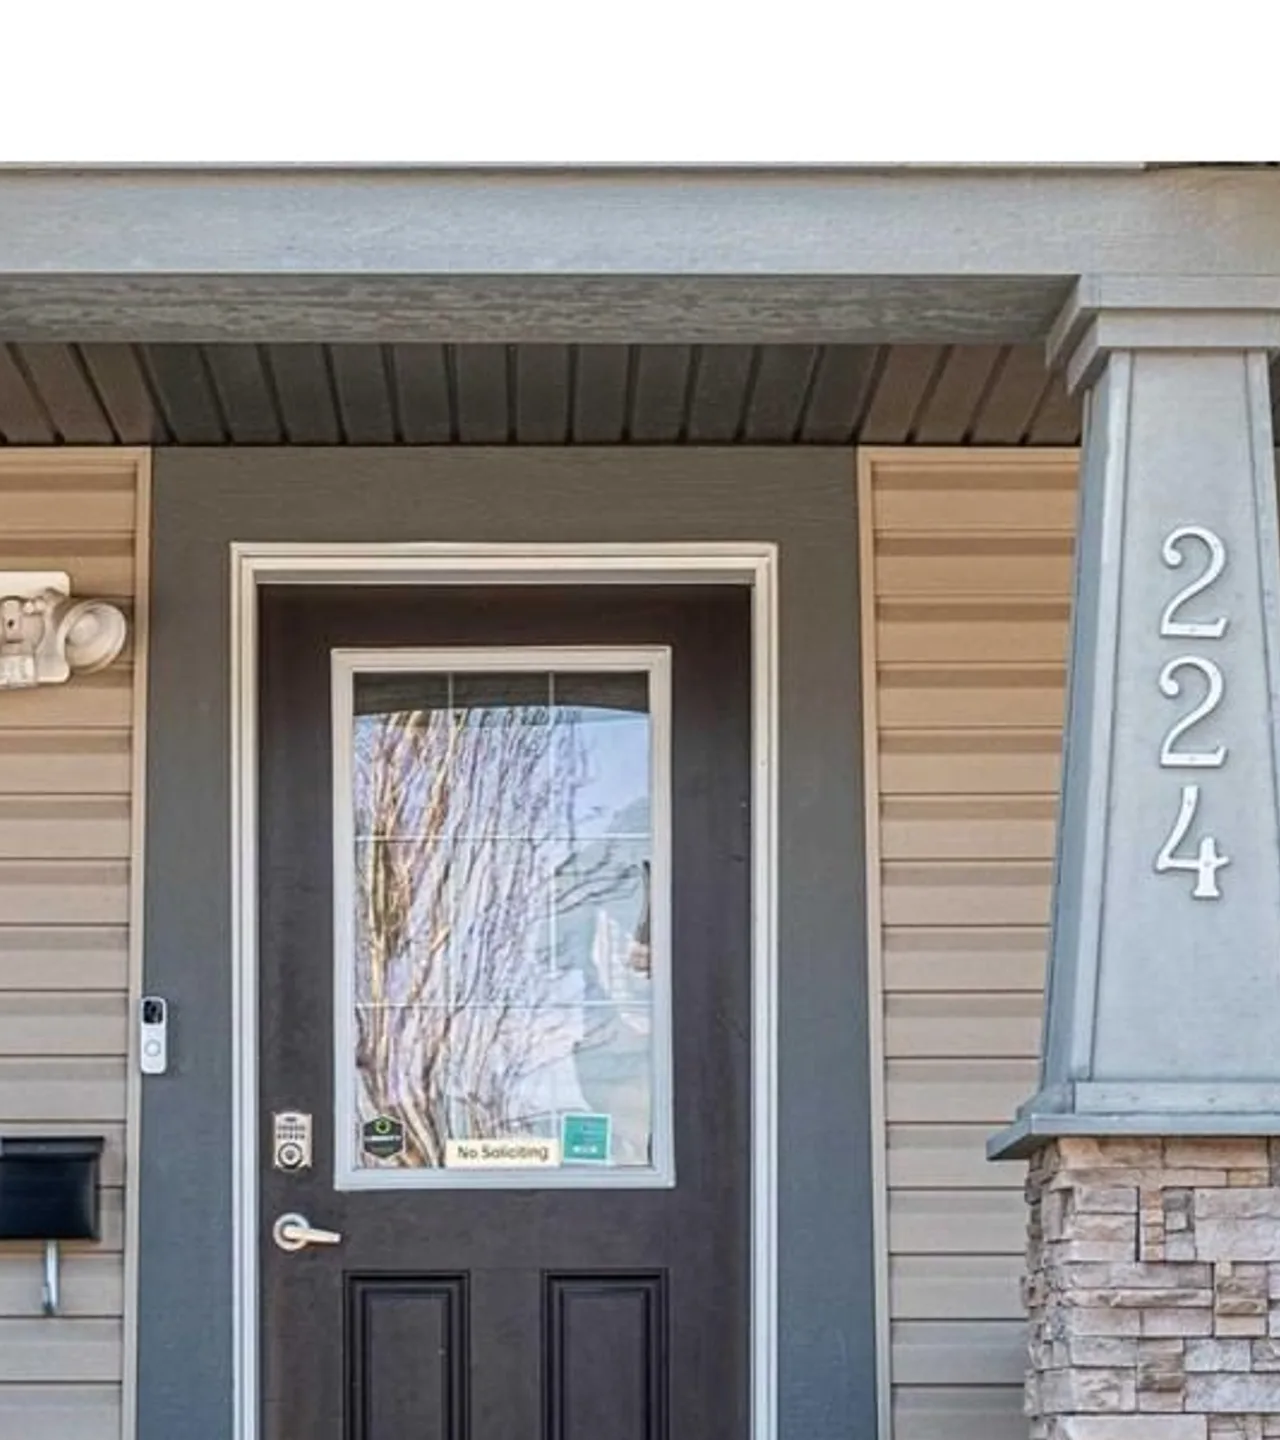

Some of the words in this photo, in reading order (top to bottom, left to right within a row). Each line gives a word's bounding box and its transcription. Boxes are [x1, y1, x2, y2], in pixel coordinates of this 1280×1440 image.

[1156, 525, 1230, 898] 224
[457, 1145, 478, 1159] No
[481, 1143, 549, 1161] Soliciting
